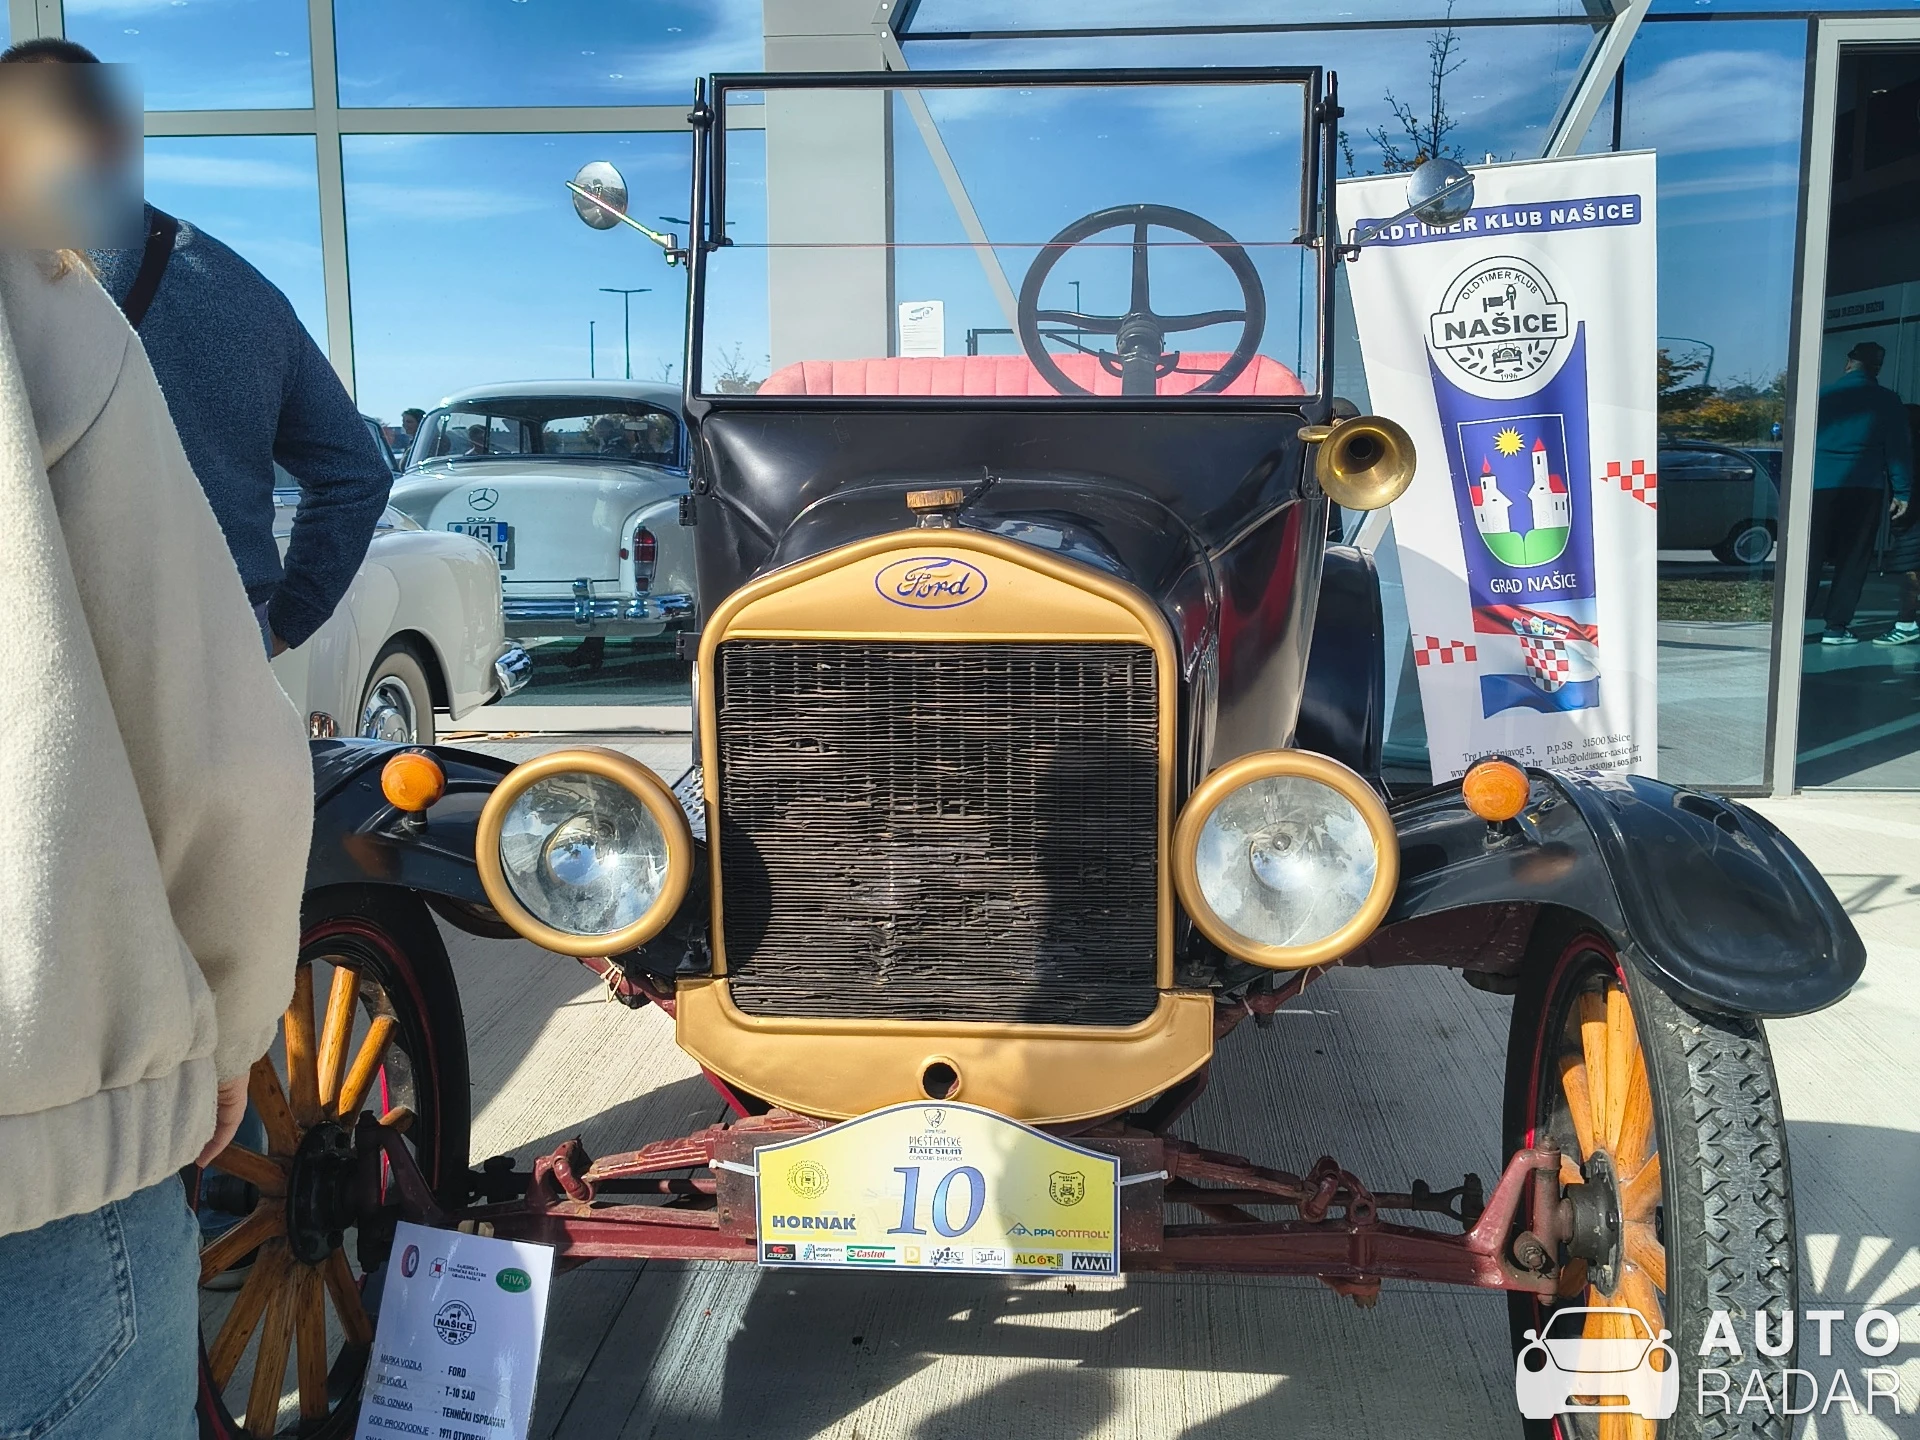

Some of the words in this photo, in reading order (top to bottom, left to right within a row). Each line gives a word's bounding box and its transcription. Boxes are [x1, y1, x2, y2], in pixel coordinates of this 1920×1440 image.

[1485, 210, 1542, 230] KLUB
[1550, 202, 1635, 224] NAŠICE
[1462, 271, 1512, 300] OLDTIMER
[1514, 272, 1538, 294] KLUB
[1445, 312, 1558, 341] NAŠICE
[1500, 372, 1518, 381] 1996
[896, 559, 971, 598] Ford
[1490, 578, 1523, 594] GRAD
[1527, 571, 1577, 592] NAŠICE
[1582, 736, 1606, 748] 31500
[887, 1165, 986, 1238] 10
[856, 1250, 886, 1260] Castrol
[502, 1274, 526, 1286] FIVA
[437, 1318, 473, 1332] NAŠICE
[400, 1358, 422, 1371] VOZILA
[448, 1366, 467, 1378] FORD
[446, 1386, 460, 1398] T-10
[388, 1398, 413, 1411] OZNAKA
[442, 1407, 472, 1422] TEHNIČKI
[473, 1412, 506, 1429] ISPRAVAN
[384, 1418, 430, 1436] PROIZVODNJE
